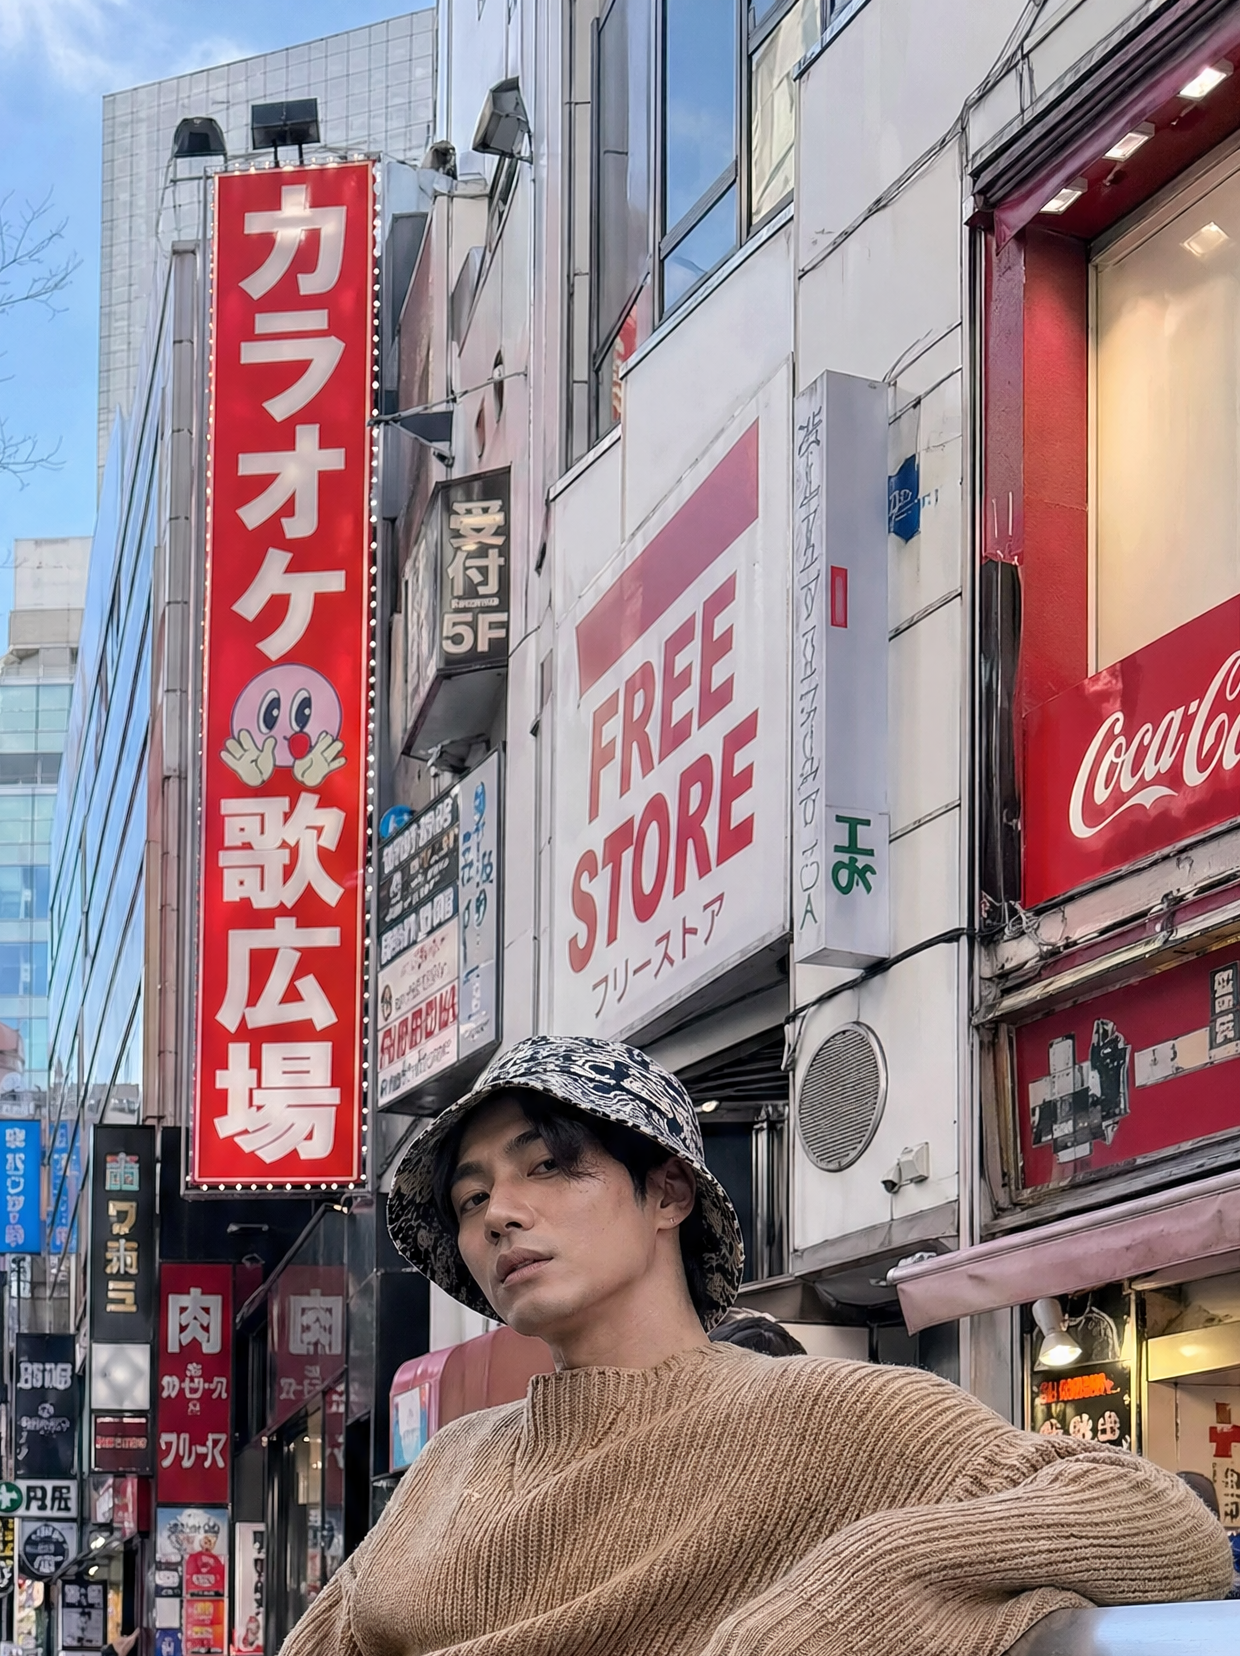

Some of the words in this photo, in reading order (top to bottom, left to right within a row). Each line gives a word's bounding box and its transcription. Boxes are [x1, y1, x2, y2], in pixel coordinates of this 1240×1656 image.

[231, 184, 347, 661] カラオケ
[442, 612, 508, 654] 5F
[447, 500, 507, 596] 受付
[588, 569, 737, 824] FREE
[568, 707, 759, 973] STORE
[214, 792, 347, 1164] 歌広場
[592, 892, 725, 1018] フリーストア
[167, 1287, 223, 1354] 肉
